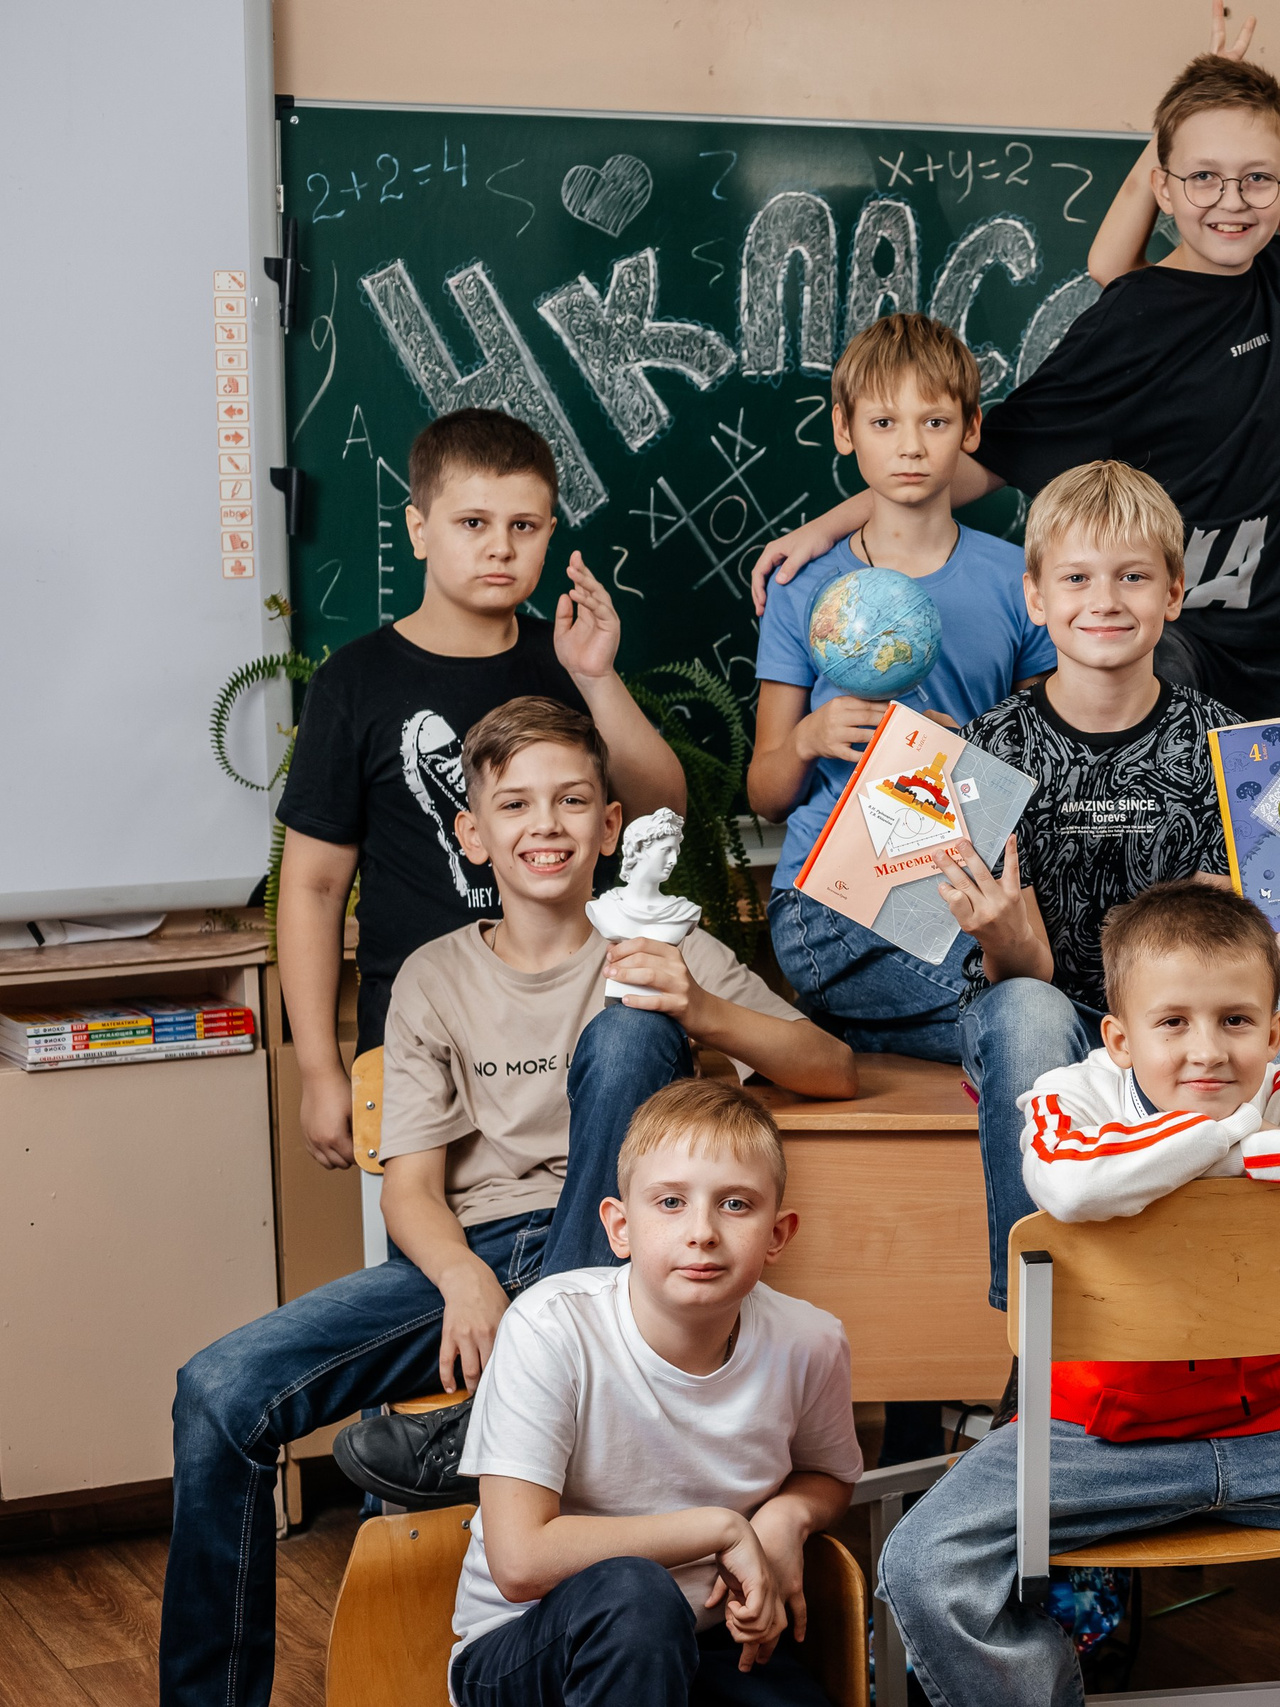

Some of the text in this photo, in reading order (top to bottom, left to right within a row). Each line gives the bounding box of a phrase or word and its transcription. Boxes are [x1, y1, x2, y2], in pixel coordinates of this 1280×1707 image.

[905, 730, 919, 748] 4
[1249, 743, 1262, 763] 4
[1061, 800, 1156, 813] AMAZING SINCE
[467, 886, 492, 908] THEY
[101, 1020, 139, 1028] МАТЕМАТИКА
[91, 1031, 133, 1040] ОКРУЖАЮЩИЙ
[473, 1061, 497, 1077] NO
[506, 1055, 557, 1077] MORE
